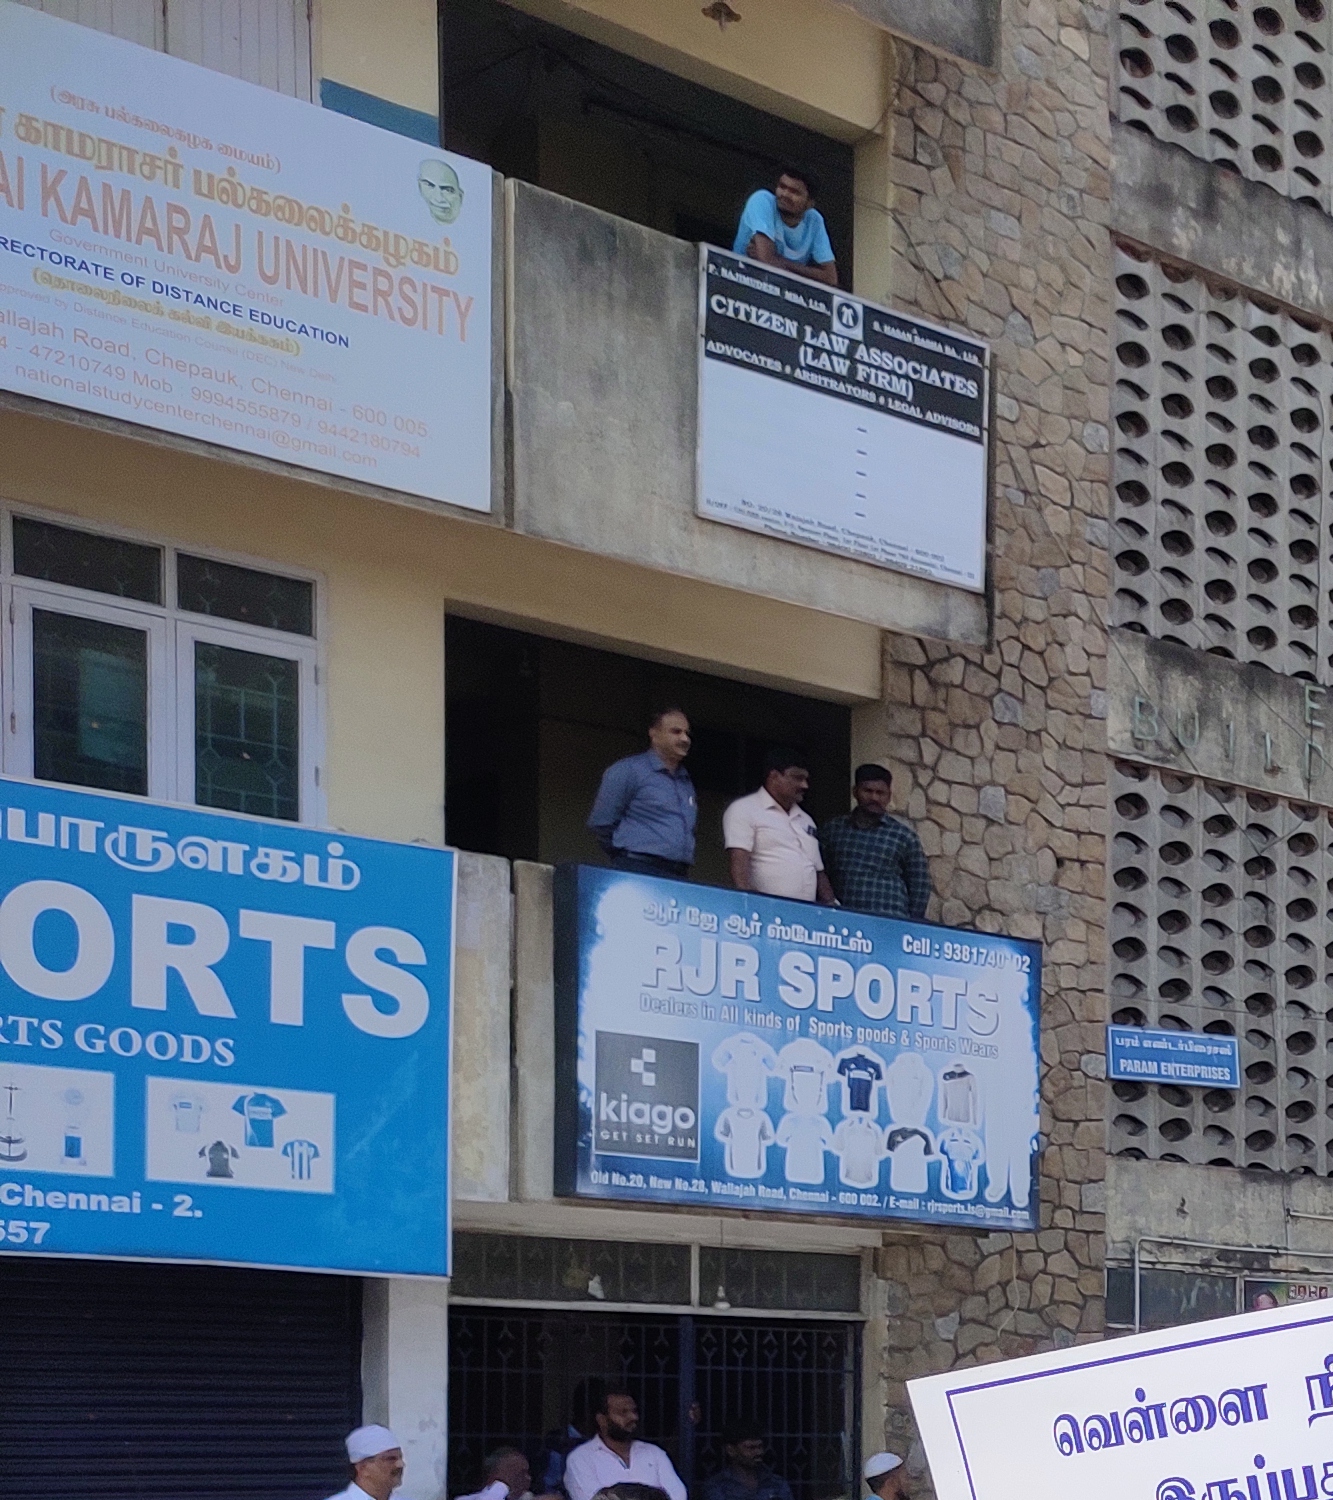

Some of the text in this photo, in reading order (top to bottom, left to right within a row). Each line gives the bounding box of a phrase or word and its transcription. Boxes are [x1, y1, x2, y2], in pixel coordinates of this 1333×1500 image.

[15, 113, 459, 275] காமராசர் பல்கலைக்கழகம்
[40, 162, 241, 274] KAMARAJ
[257, 230, 473, 343] UNIVERSITY
[50, 229, 230, 292] Government University
[120, 272, 146, 288] OF
[152, 280, 243, 318] DISTANCE
[249, 309, 349, 348] EDUCATION
[710, 294, 799, 339] CITIZEN
[804, 324, 850, 355] LAW
[854, 343, 979, 400] ASSOCIATES
[799, 344, 915, 401] (LAW FIRM)
[132, 369, 174, 395] Mob
[144, 348, 387, 427] Chepauk, Chennai 600
[707, 340, 980, 438] ADVOCATES ARBITRATORS LEGAL ADVISORS
[0, 878, 430, 1039] ORTS
[643, 898, 680, 926] ஆர்
[724, 912, 763, 940] ஆர்
[767, 917, 874, 956] ஸ்போர்ட்ஸ்
[903, 934, 1032, 974] Cell 938174002
[641, 933, 1001, 1037] RJR SPORTS
[73, 1022, 236, 1067] GOODS
[640, 993, 1000, 1060] Dealers in All kinds of Sports goods Sports Wears
[1115, 1036, 1139, 1048] பரம்
[1120, 1059, 1230, 1080] PARAM ENTERPRISES
[599, 1092, 697, 1136] kiago
[600, 1128, 697, 1150] GET SET RUN
[0, 1183, 142, 1214] Chennai
[1051, 1387, 1271, 1460] வெள்ளை
